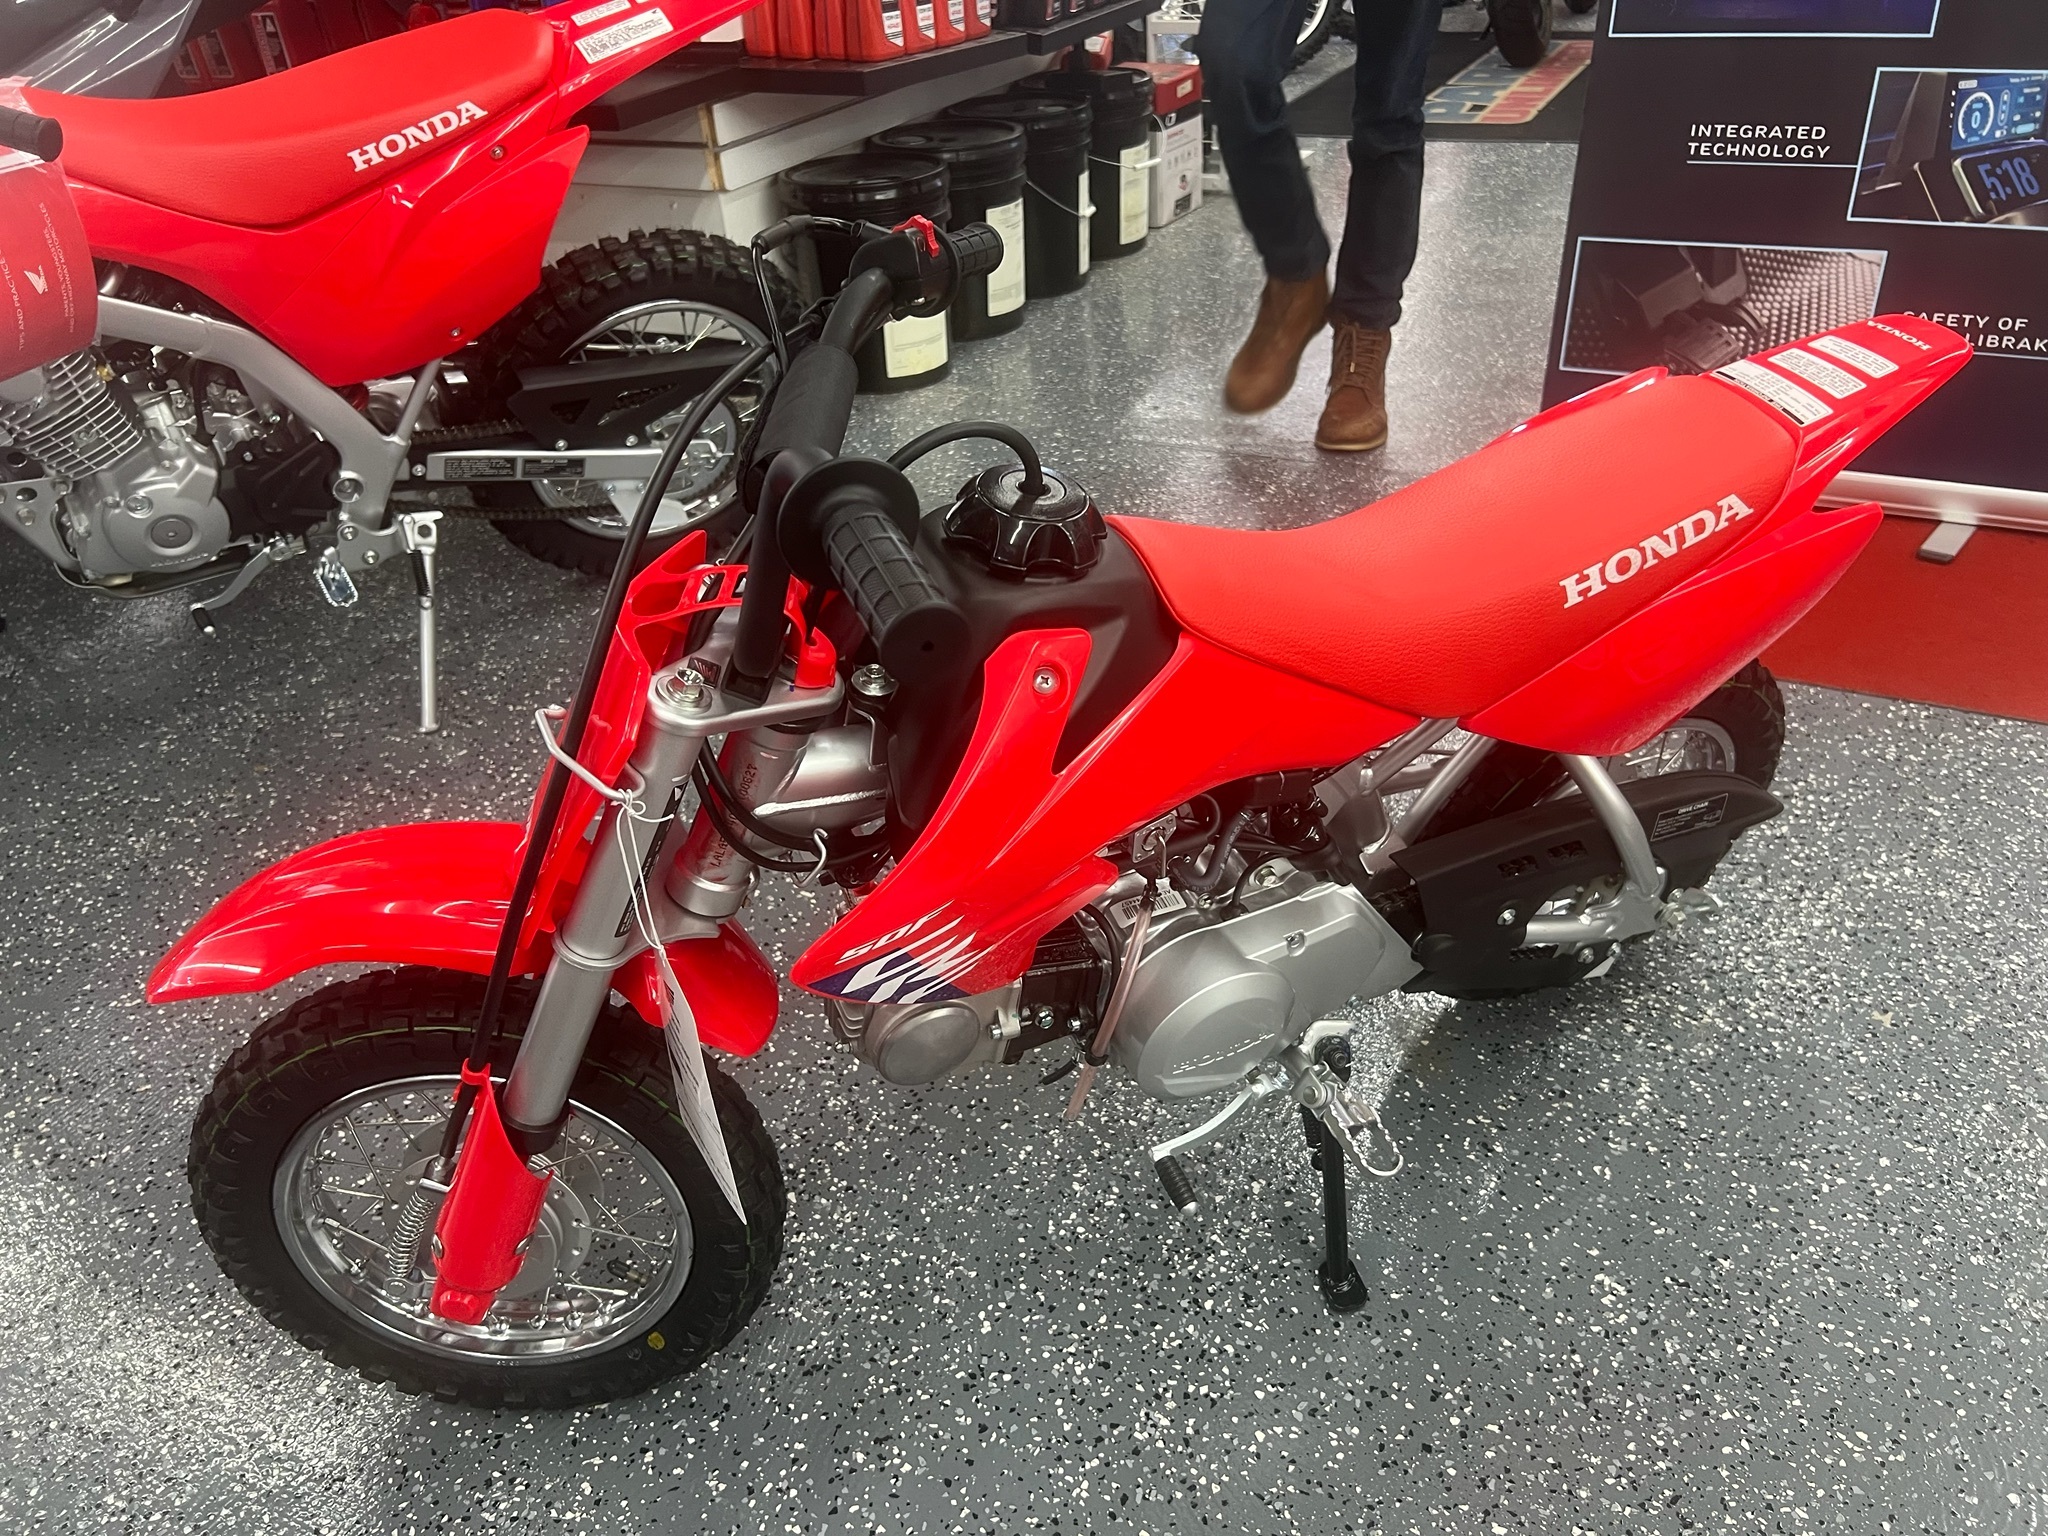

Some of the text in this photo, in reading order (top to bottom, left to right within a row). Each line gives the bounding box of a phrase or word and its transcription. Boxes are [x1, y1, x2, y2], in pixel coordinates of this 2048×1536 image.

[347, 101, 489, 172] HONDA
[1690, 124, 1826, 140] INTEGRATED
[1688, 142, 1830, 159] TECHNOLOGY
[1977, 157, 2040, 200] 5:18
[16, 308, 25, 331] AND
[1903, 311, 2029, 331] AFETY OF
[1867, 319, 1932, 351] HONDA
[1559, 493, 1754, 609] HONDA
